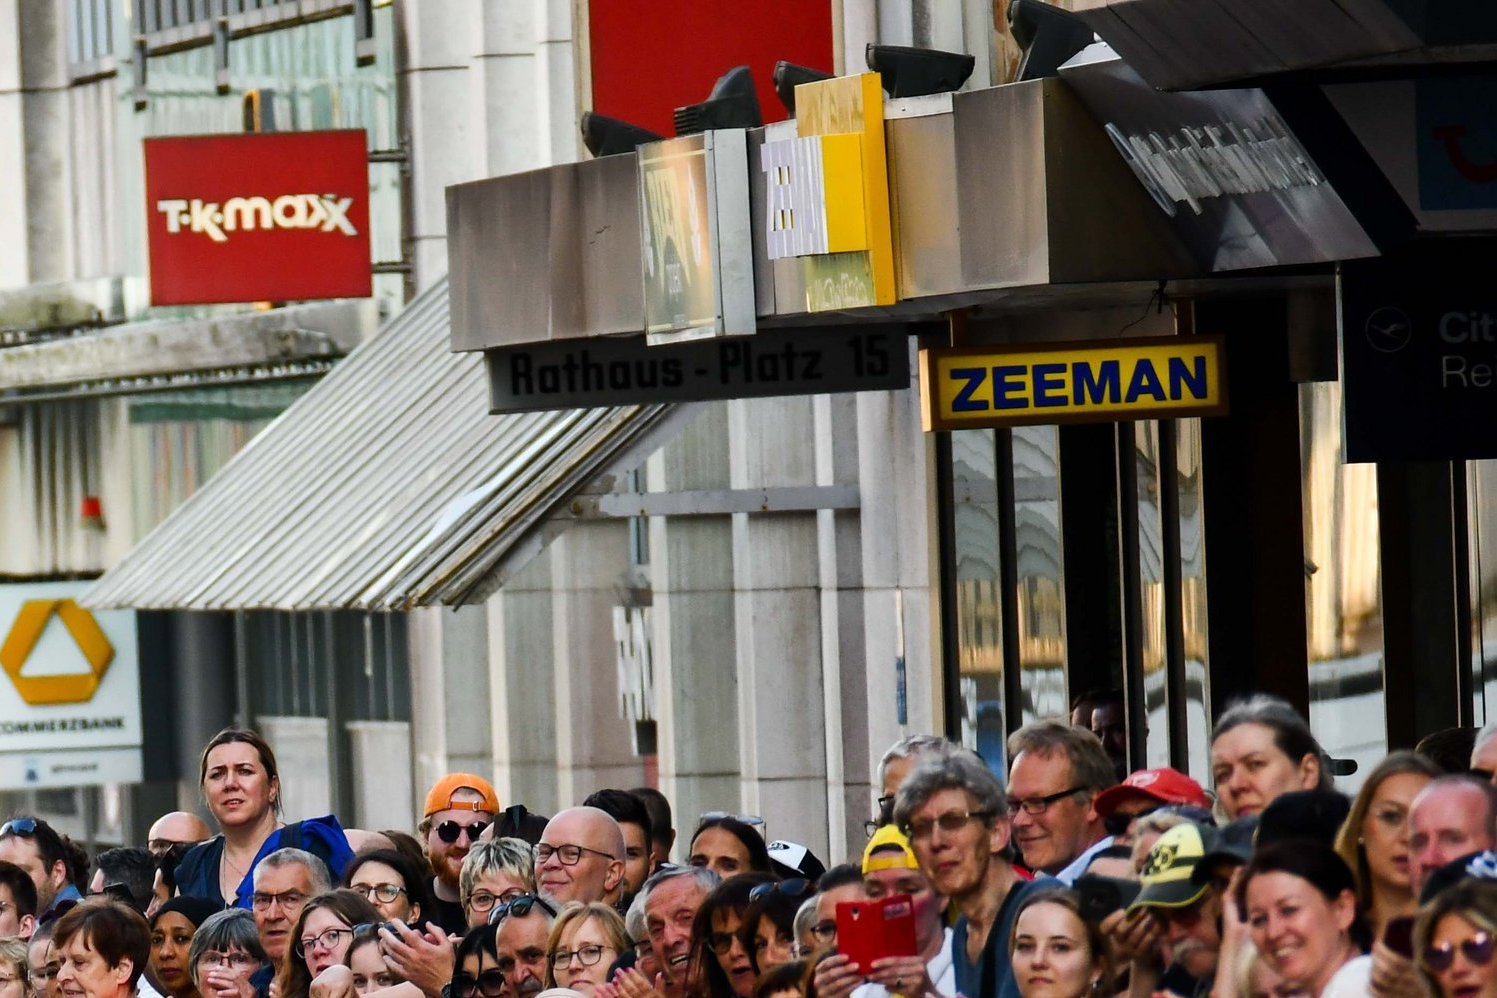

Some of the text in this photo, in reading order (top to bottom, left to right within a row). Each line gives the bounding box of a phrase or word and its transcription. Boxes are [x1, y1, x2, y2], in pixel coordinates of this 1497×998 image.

[1439, 310, 1497, 343] Cit
[510, 350, 684, 396] Rathaus
[718, 339, 824, 385] Platz
[847, 334, 890, 378] 15
[949, 355, 1208, 413] ZEEMAN
[1441, 354, 1497, 389] Re
